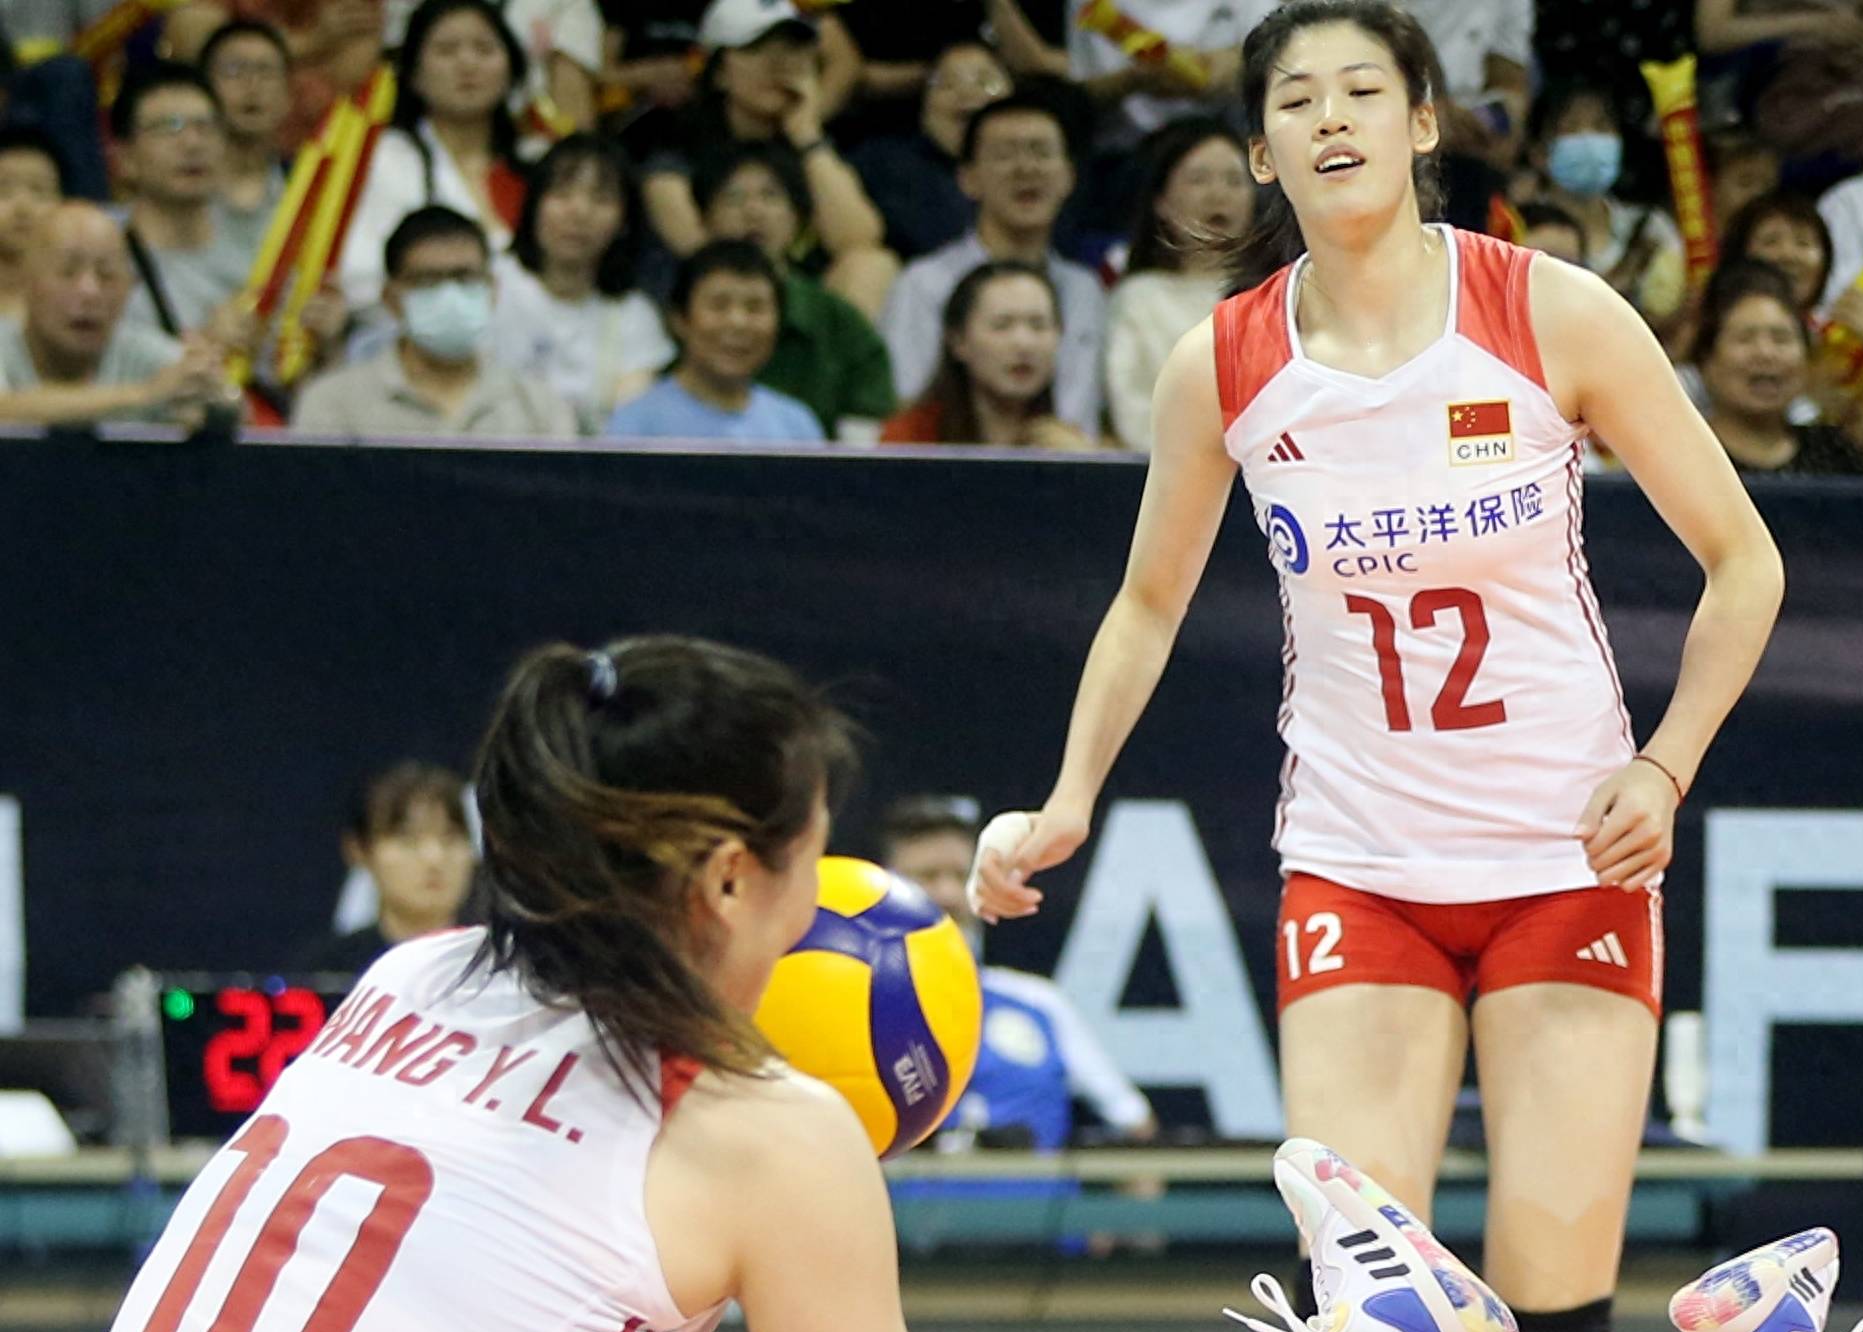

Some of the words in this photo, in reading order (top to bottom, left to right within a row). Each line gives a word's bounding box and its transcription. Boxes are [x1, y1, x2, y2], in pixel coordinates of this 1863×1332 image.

[1456, 441, 1508, 461] CHN
[1323, 482, 1545, 551] 太平洋保险
[1332, 552, 1419, 578] CPIC
[1342, 586, 1508, 732] 12
[1282, 910, 1345, 981] 12
[203, 985, 326, 1113] 22
[462, 1045, 539, 1111] Y.
[521, 1050, 585, 1145] L.
